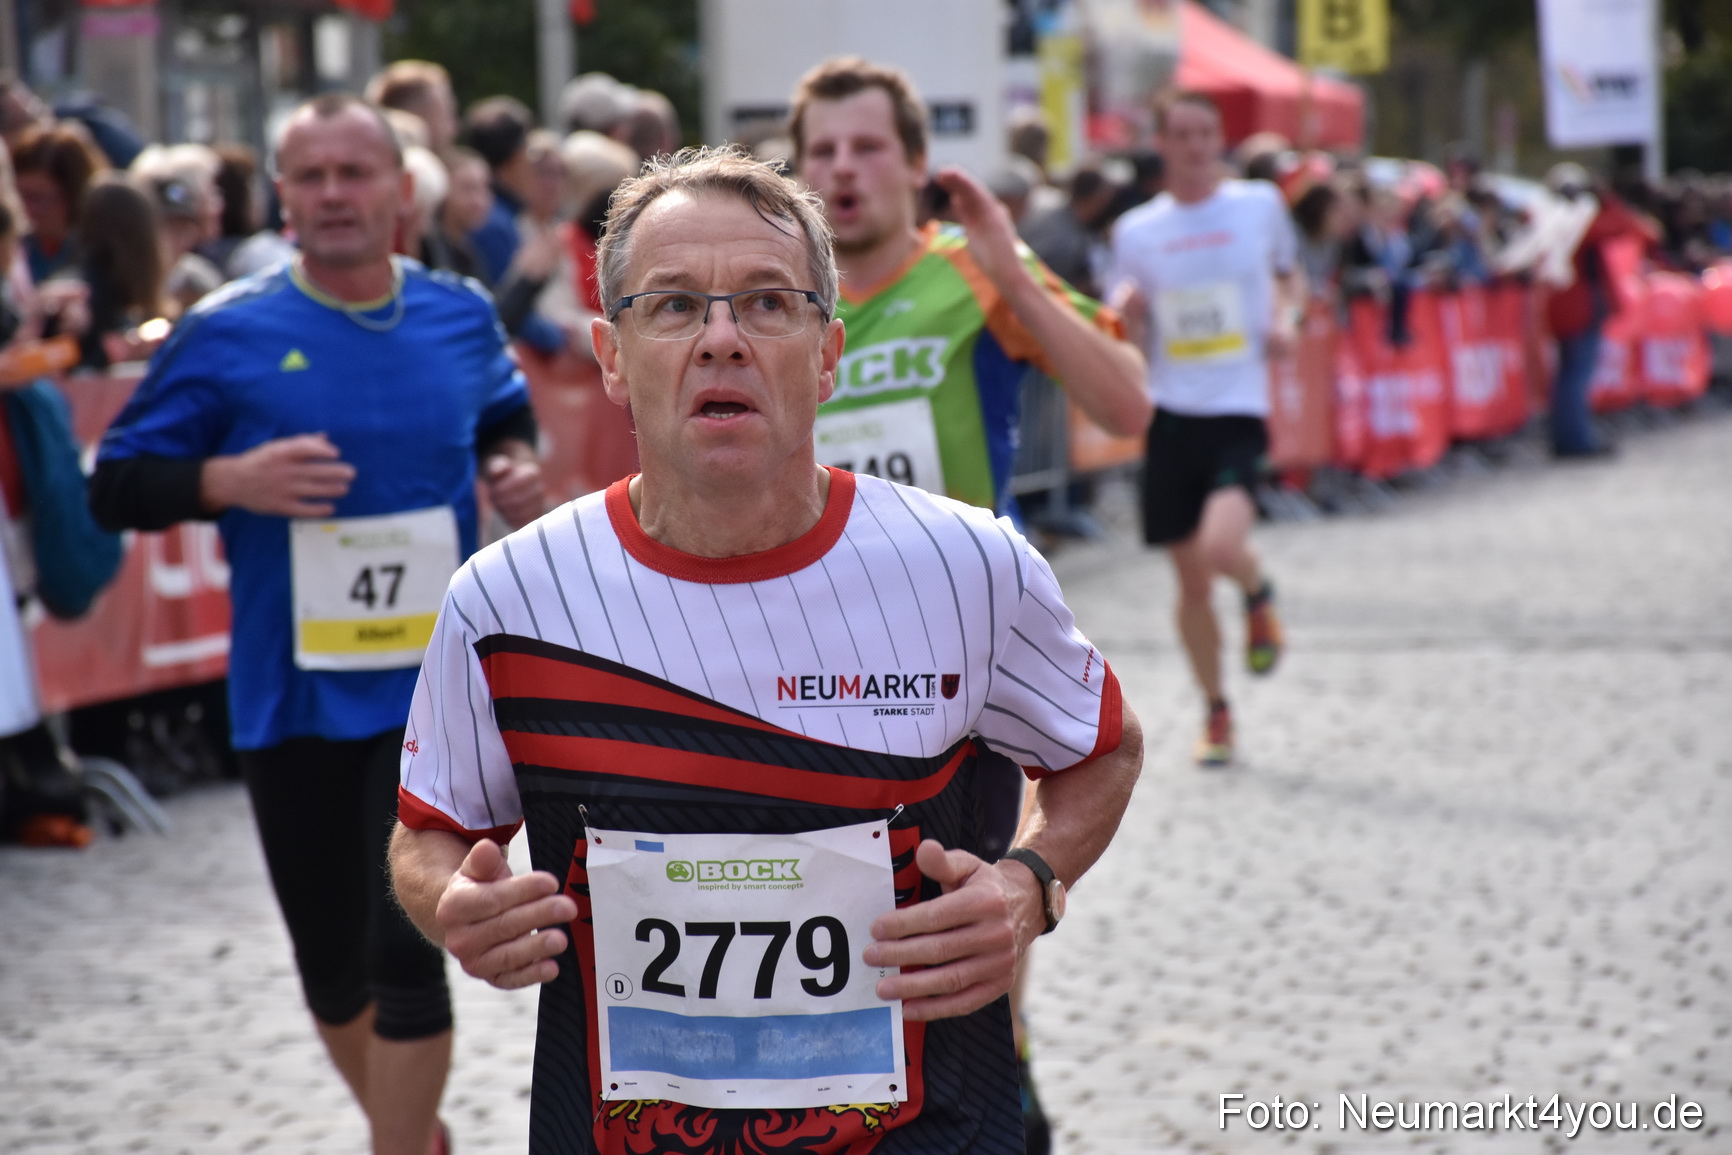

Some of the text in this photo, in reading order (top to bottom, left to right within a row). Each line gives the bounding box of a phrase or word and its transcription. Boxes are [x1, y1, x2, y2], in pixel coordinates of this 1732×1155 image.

[350, 563, 405, 610] 47
[777, 674, 936, 701] NEUMARKT
[873, 707, 935, 716] STARKE STADT
[696, 859, 803, 882] BOCK
[697, 882, 804, 892] inspired by smart concepts
[635, 916, 850, 999] 2779
[614, 980, 625, 994] D
